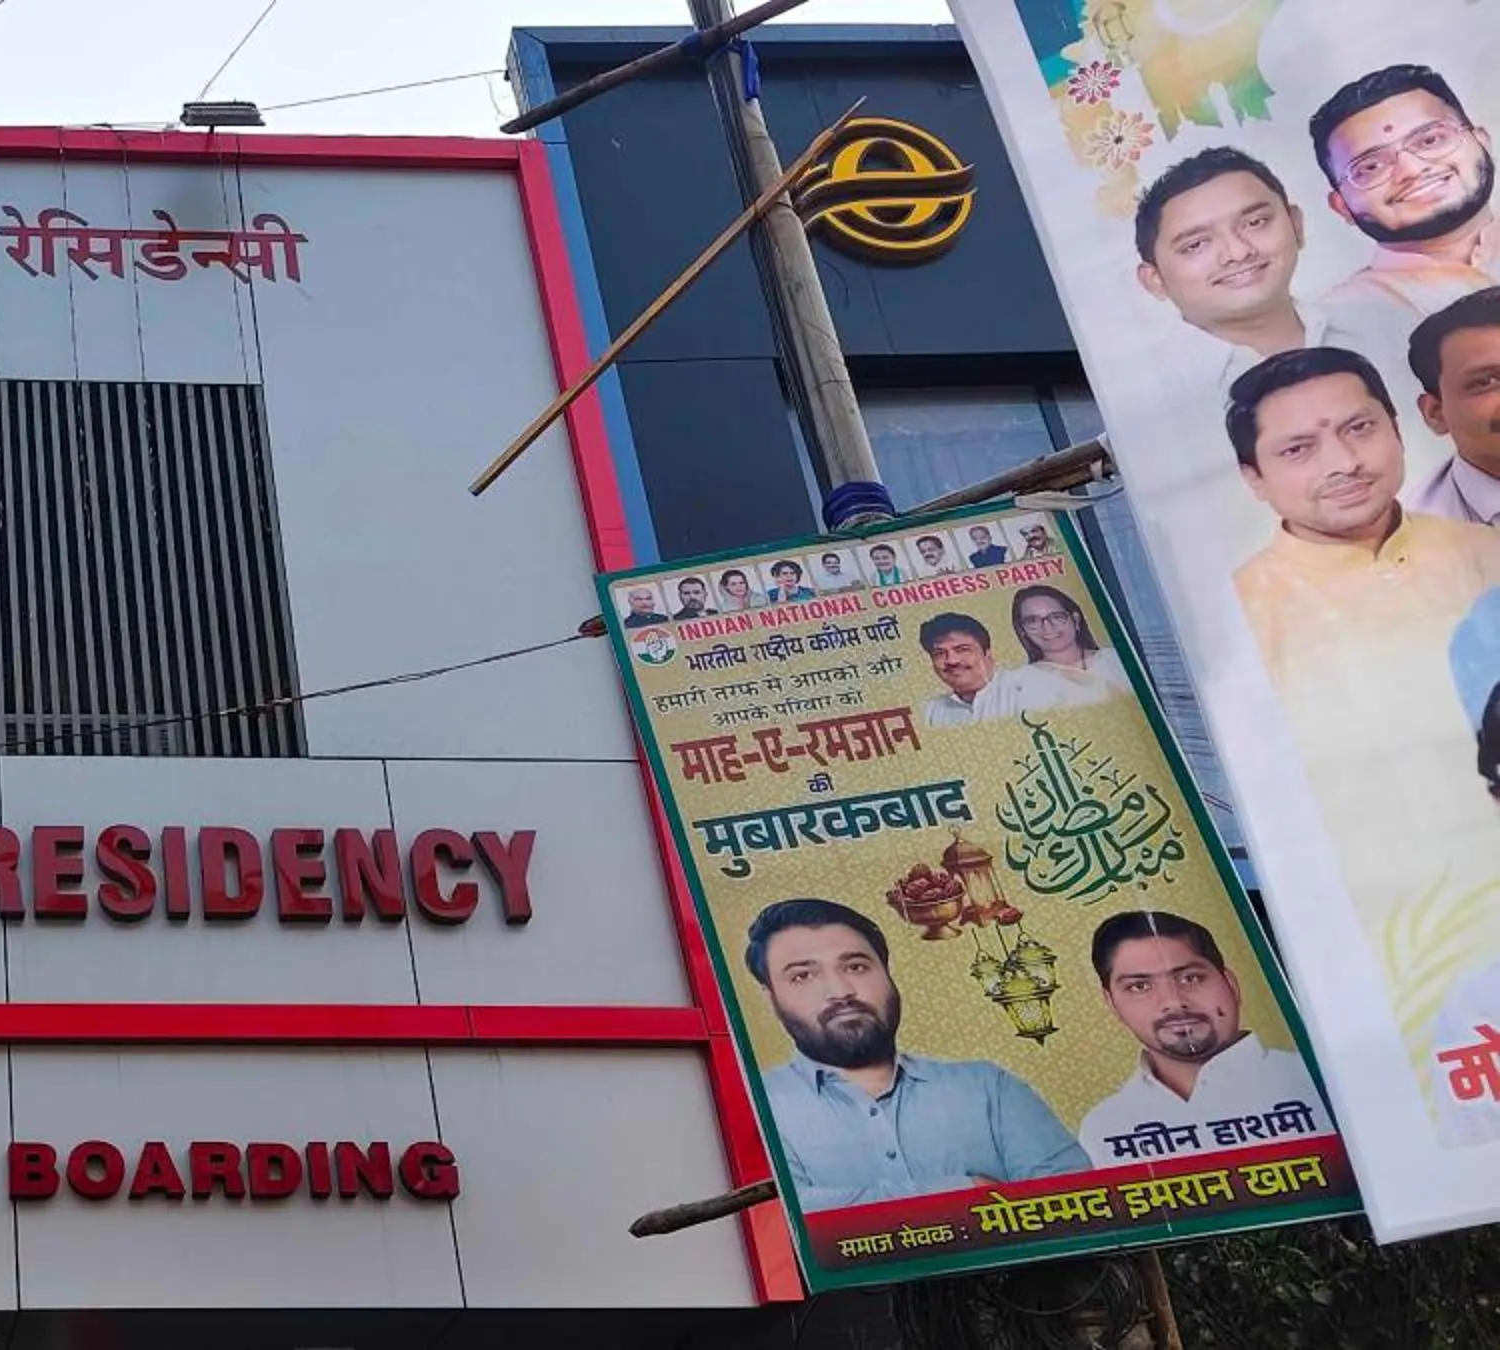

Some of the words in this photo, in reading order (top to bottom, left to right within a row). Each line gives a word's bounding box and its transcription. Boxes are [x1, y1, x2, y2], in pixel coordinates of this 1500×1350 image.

[677, 614, 753, 641] INDIAN
[759, 594, 868, 628] NATIONAL
[871, 573, 991, 609] CONGRESS
[996, 557, 1066, 587] PARTY
[685, 644, 748, 672] भारतीय
[753, 634, 805, 664] राष्ट्रीय
[862, 614, 902, 643] पार्टी
[652, 685, 707, 712] हमारी
[712, 681, 759, 703] तरफ
[762, 673, 784, 692] से
[789, 662, 861, 689] आपको
[866, 654, 904, 675] और
[713, 703, 770, 727] आपके
[774, 694, 833, 716] परिवार
[670, 706, 922, 784] माह-ए-रमजान
[806, 772, 835, 793] की
[692, 780, 973, 877] मुबारकबाद
[1103, 1121, 1202, 1159] मतीन
[1206, 1100, 1317, 1147] हाशमी
[8, 1140, 461, 1202] BOARDING
[836, 1231, 895, 1258] समाज
[898, 1224, 955, 1249] सेवक
[970, 1191, 1113, 1234] मोहम्मद
[1118, 1170, 1236, 1219] इमरान
[1239, 1156, 1328, 1197] खान
